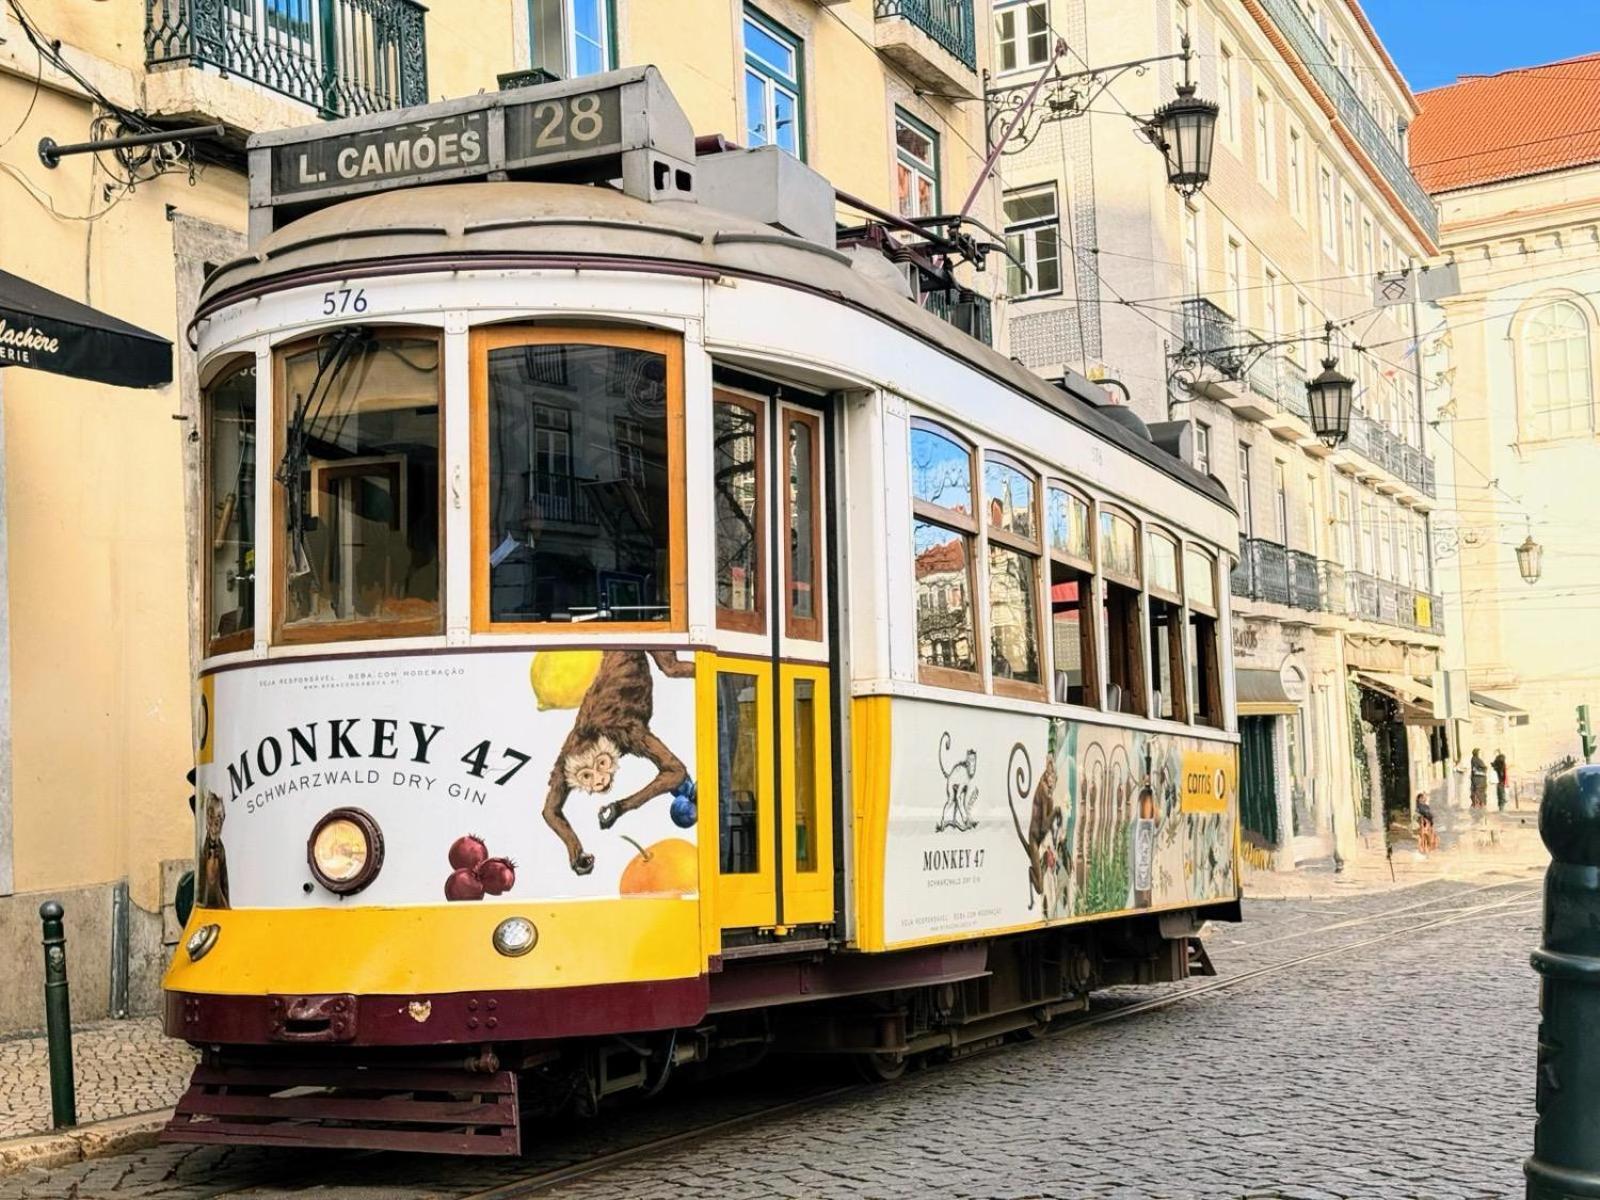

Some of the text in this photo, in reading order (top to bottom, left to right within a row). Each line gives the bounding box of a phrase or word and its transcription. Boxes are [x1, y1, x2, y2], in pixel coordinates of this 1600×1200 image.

[535, 95, 603, 148] 28
[300, 154, 326, 183] L.
[323, 289, 367, 315] 576
[226, 718, 532, 802] MONKEY 47
[246, 770, 488, 814] SCHWARZWALD DRY GIN
[1187, 766, 1212, 794] carris
[922, 849, 985, 871] MONKEY 47
